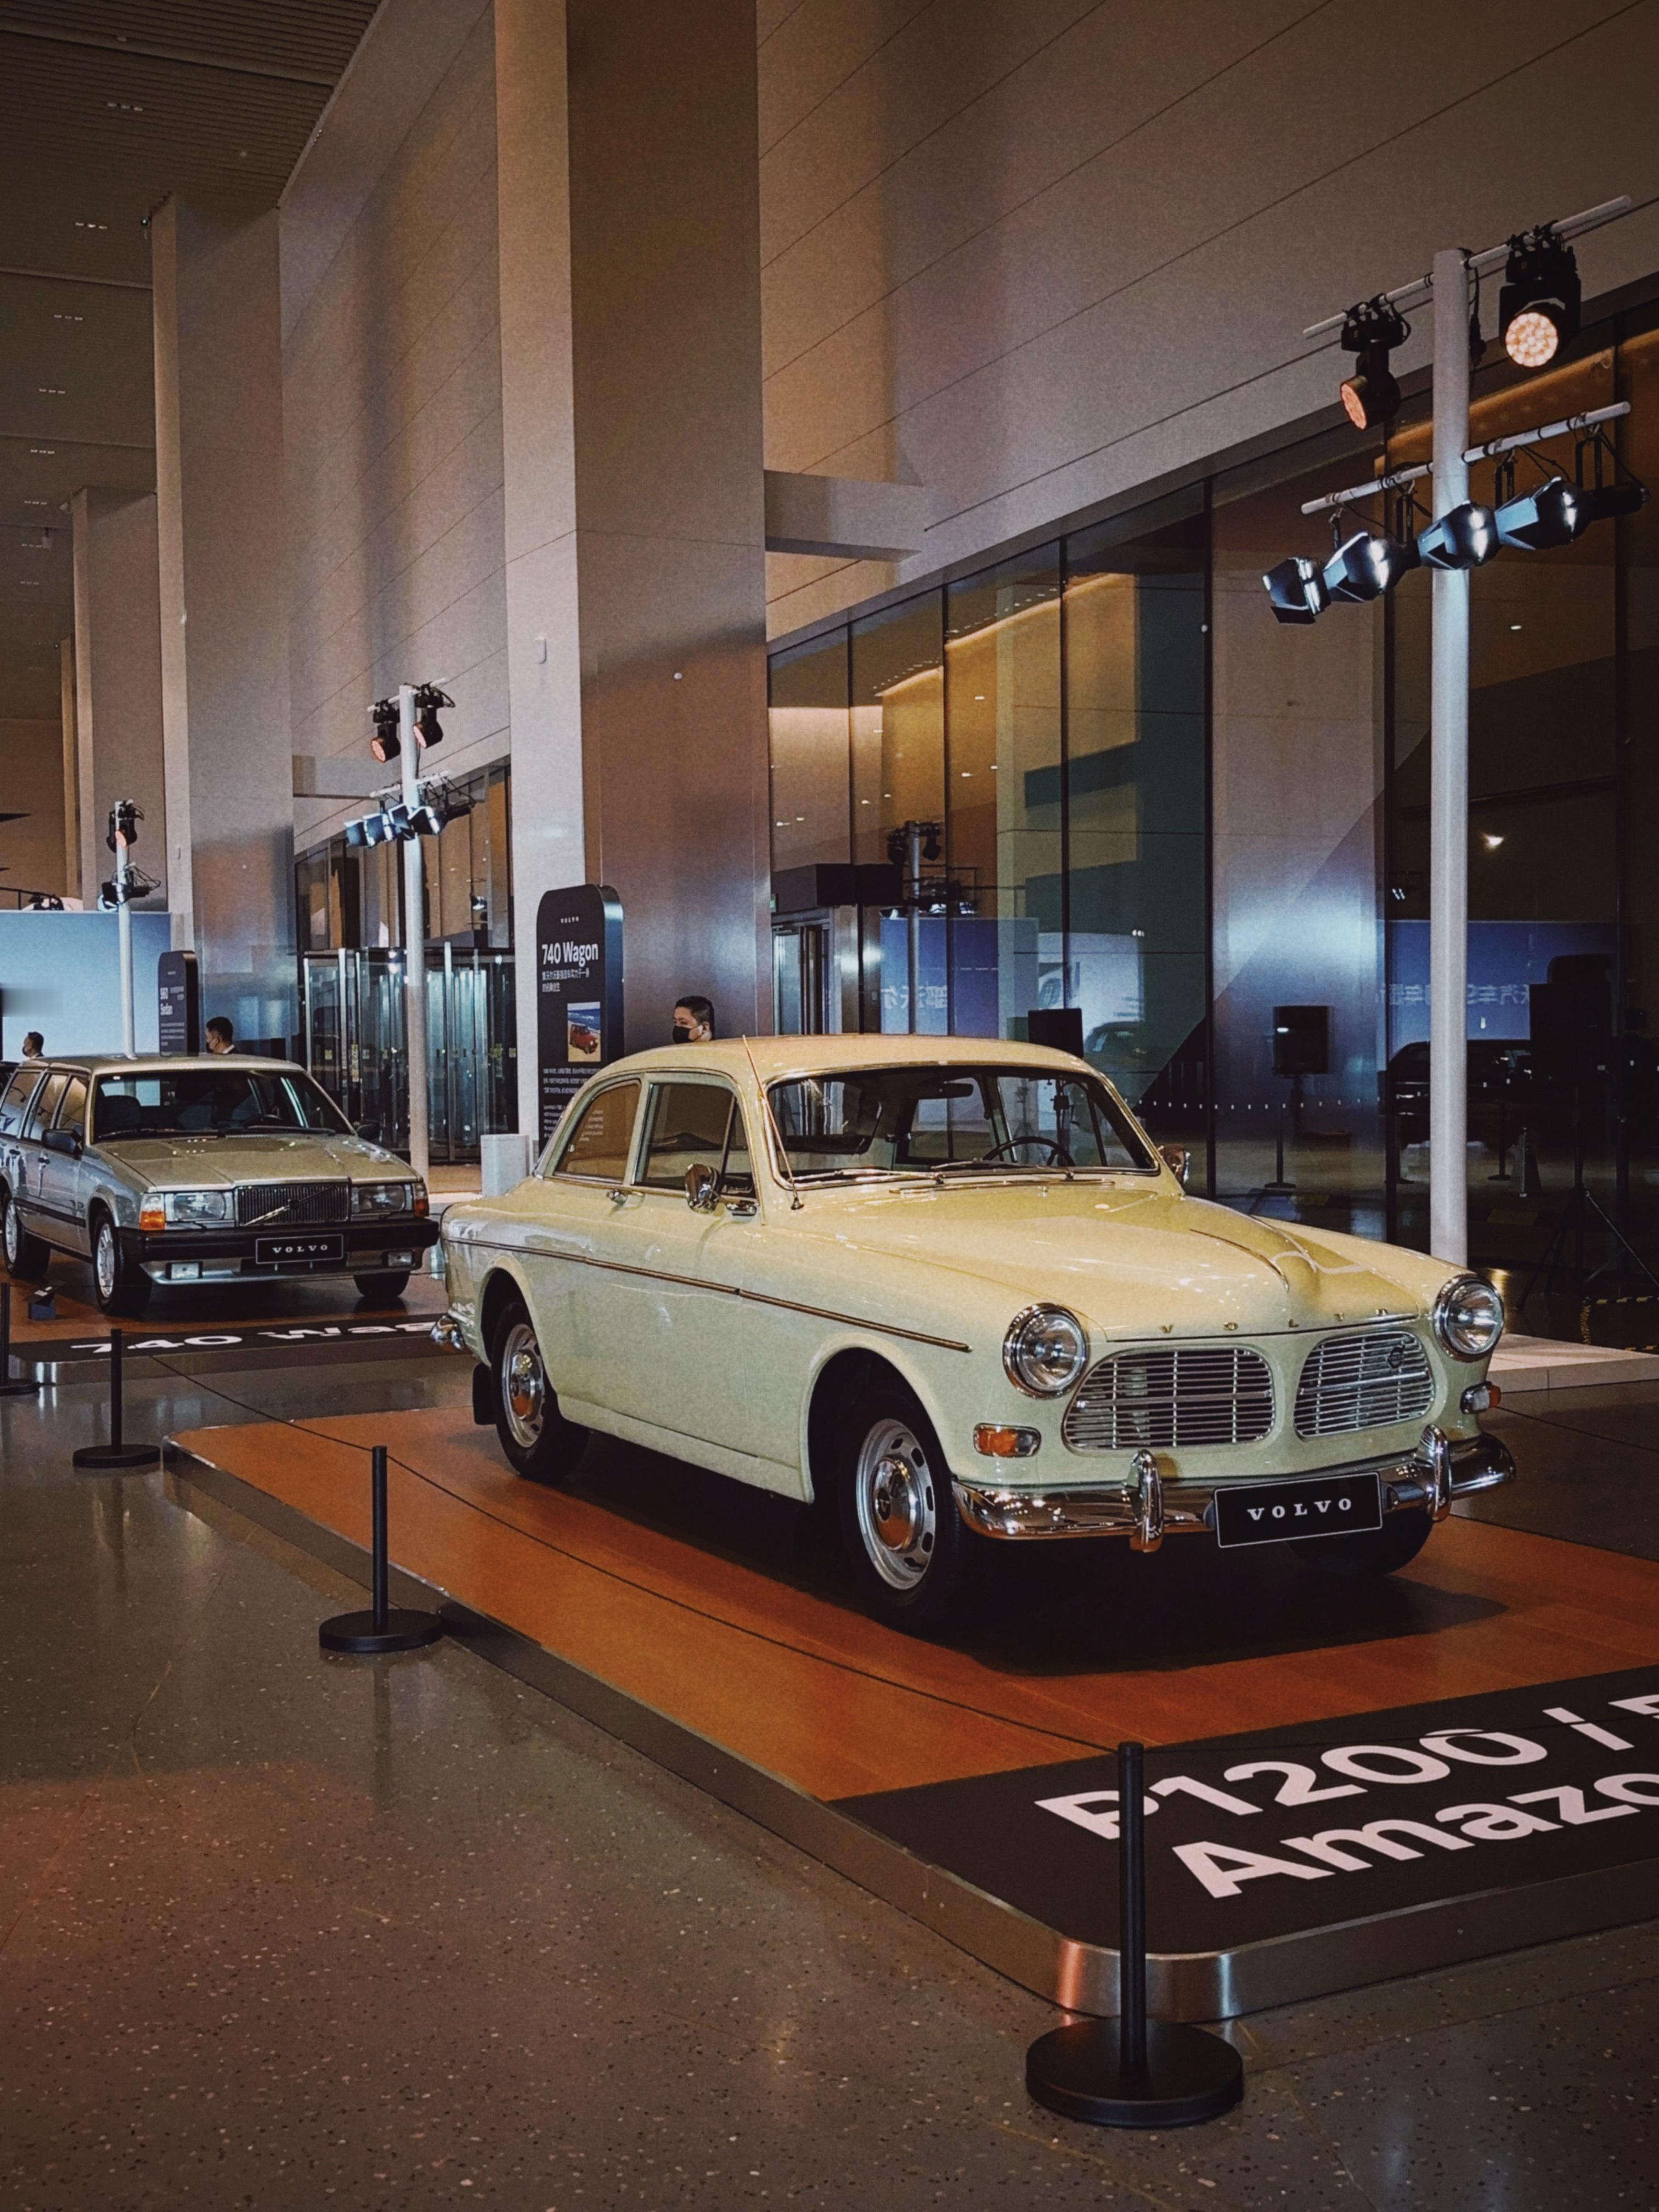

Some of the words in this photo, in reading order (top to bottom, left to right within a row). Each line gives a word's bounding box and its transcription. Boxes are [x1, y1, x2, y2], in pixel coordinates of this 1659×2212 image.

[541, 942, 561, 965] 740
[562, 941, 599, 967] Wagon
[272, 1244, 328, 1254] VOLVO
[70, 1335, 243, 1353] 740
[1246, 1498, 1352, 1521] VOLVO
[1034, 1728, 1548, 1840] P1200
